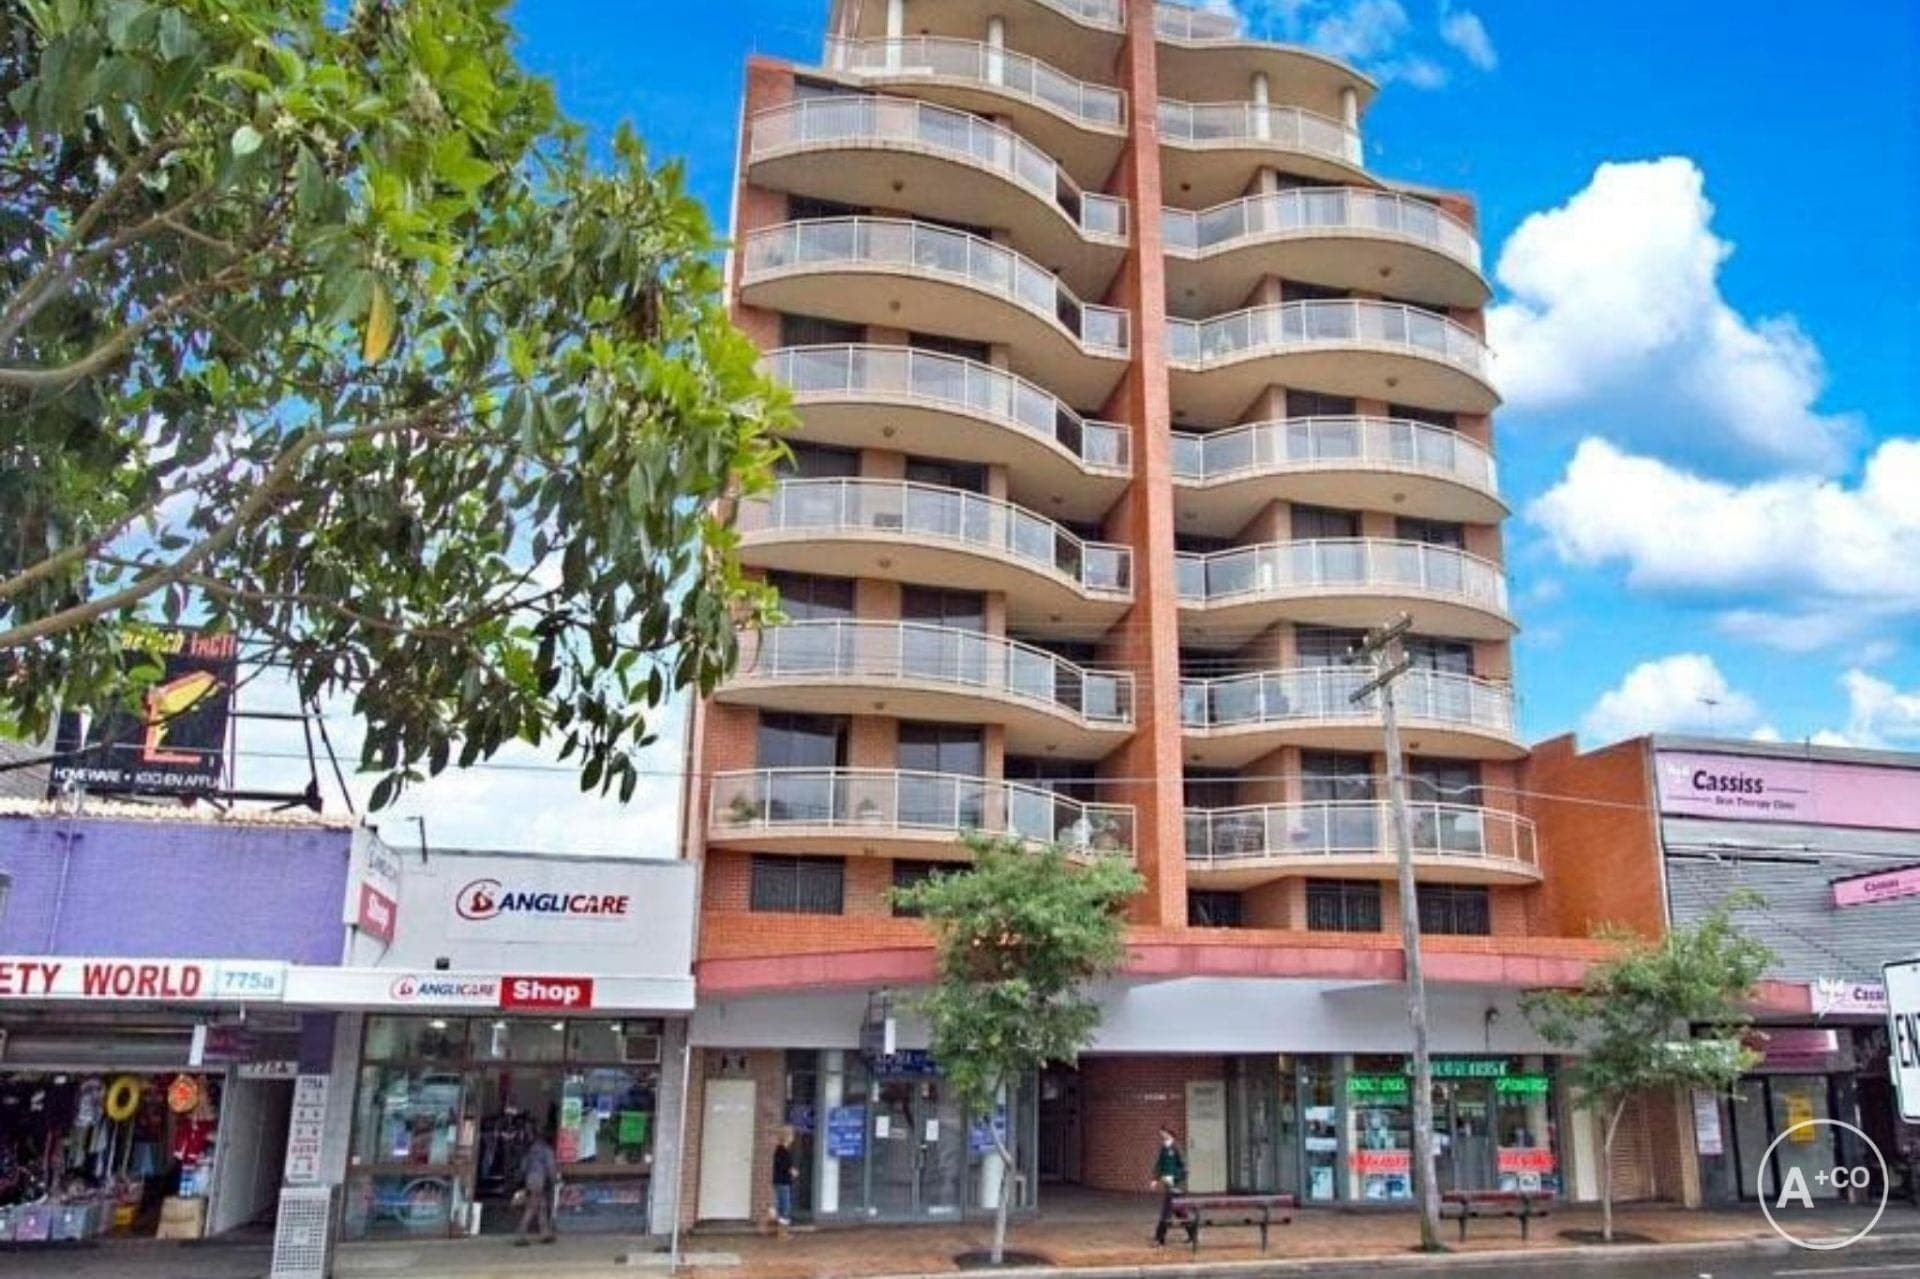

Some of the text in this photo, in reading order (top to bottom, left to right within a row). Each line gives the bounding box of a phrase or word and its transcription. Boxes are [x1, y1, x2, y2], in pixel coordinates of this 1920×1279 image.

[1693, 769, 1763, 794] Cassiss
[499, 893, 630, 914] ANGLICARE
[82, 964, 201, 997] WORLD
[224, 970, 275, 990] 775a
[417, 983, 497, 997] ANGLICARE
[512, 978, 581, 1005] Shop
